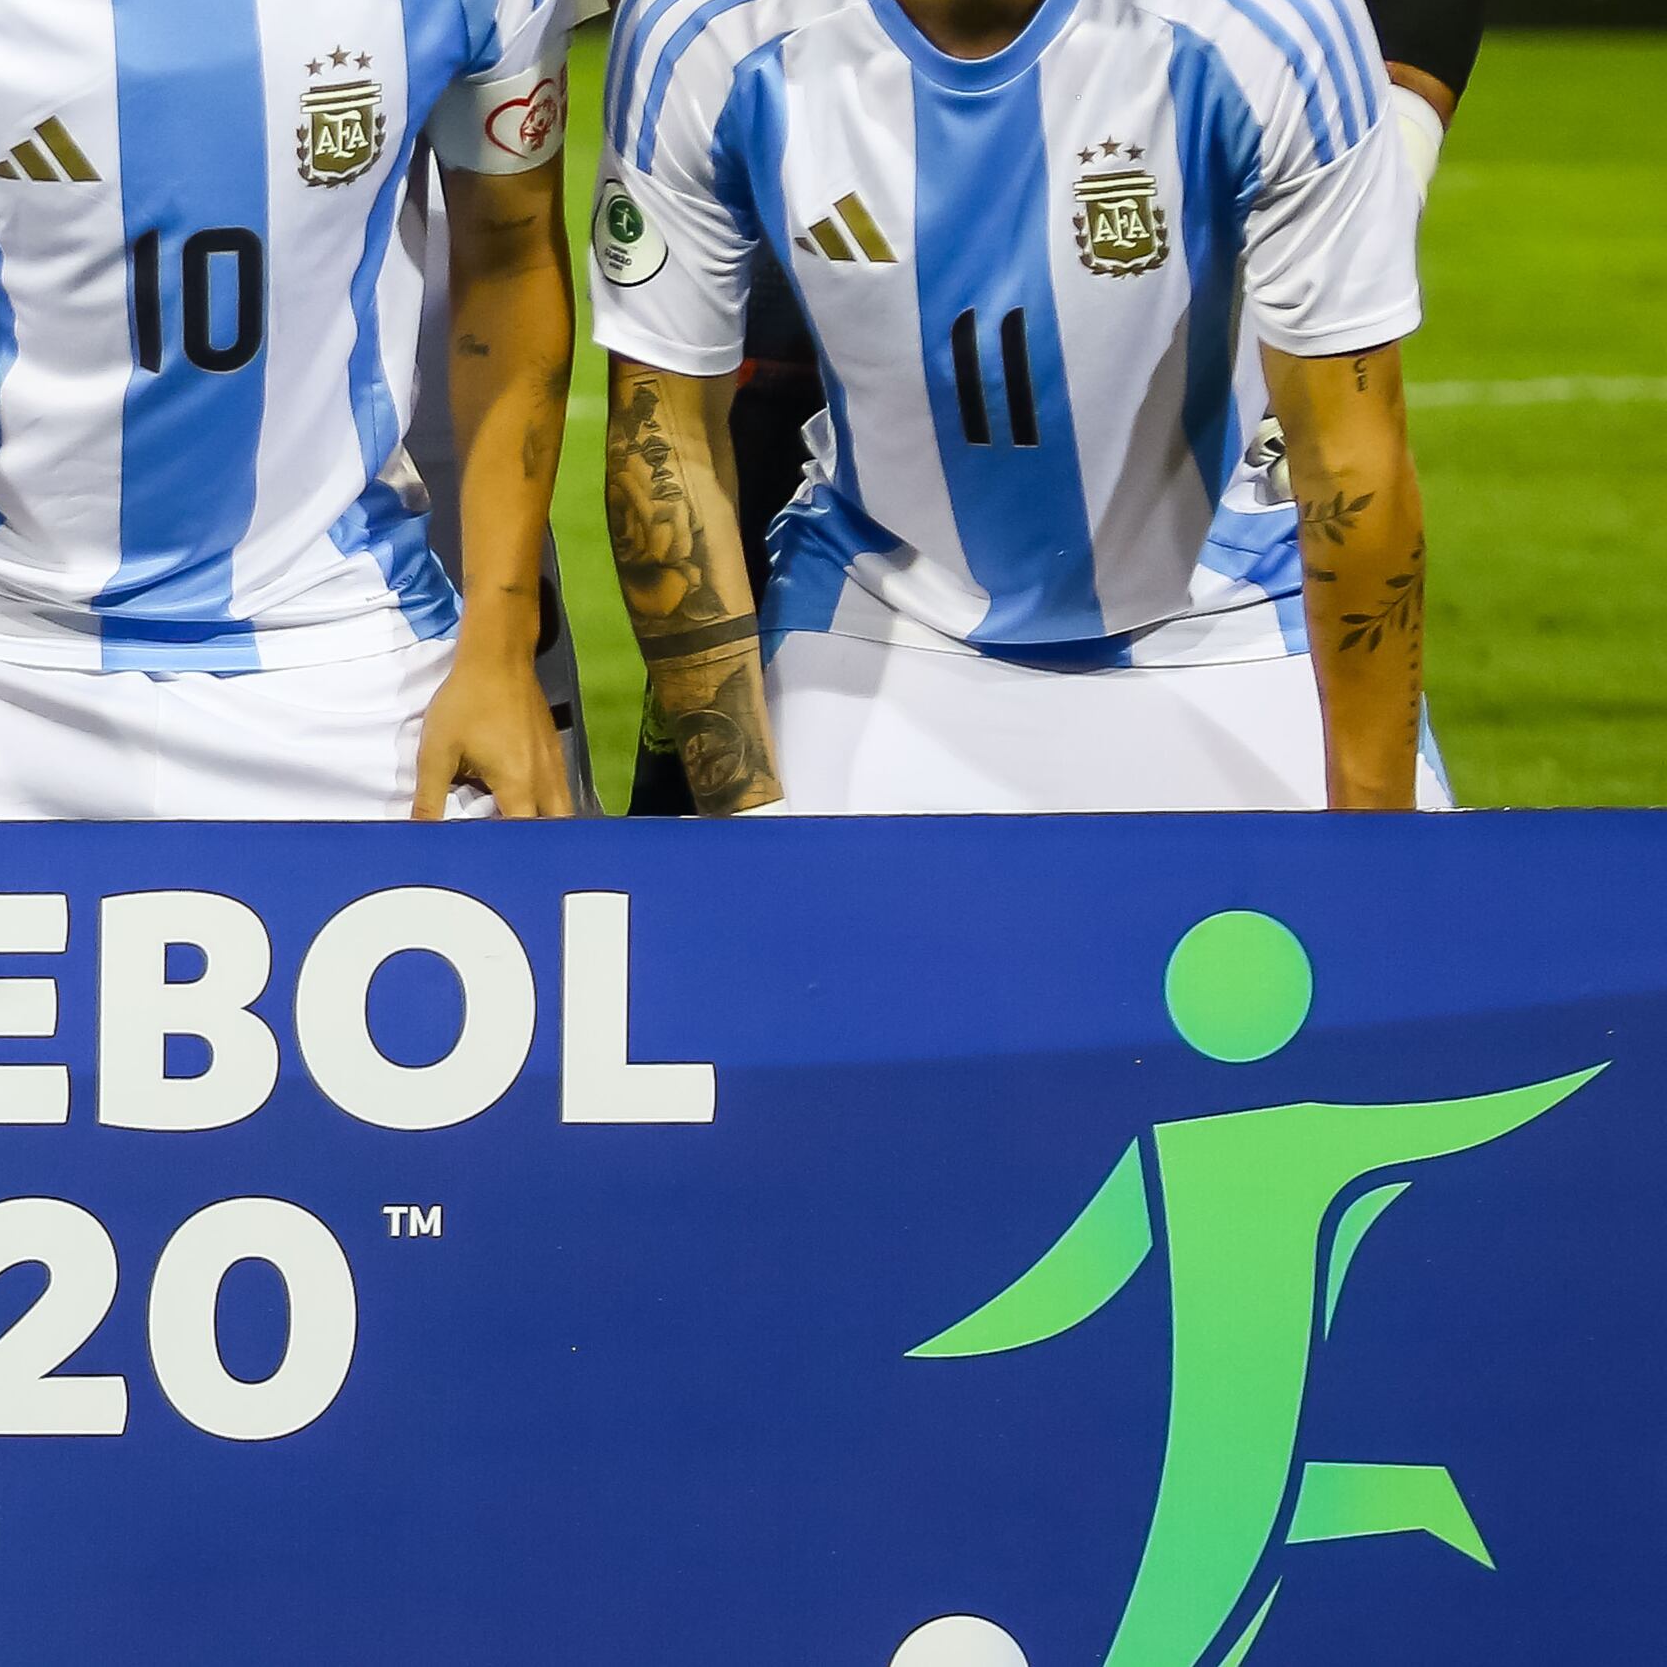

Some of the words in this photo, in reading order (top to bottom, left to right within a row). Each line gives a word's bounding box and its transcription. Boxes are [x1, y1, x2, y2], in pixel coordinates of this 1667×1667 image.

[315, 109, 370, 159] AFA
[1092, 198, 1151, 248] AFA
[131, 226, 265, 374] 10
[949, 306, 1041, 447] 11
